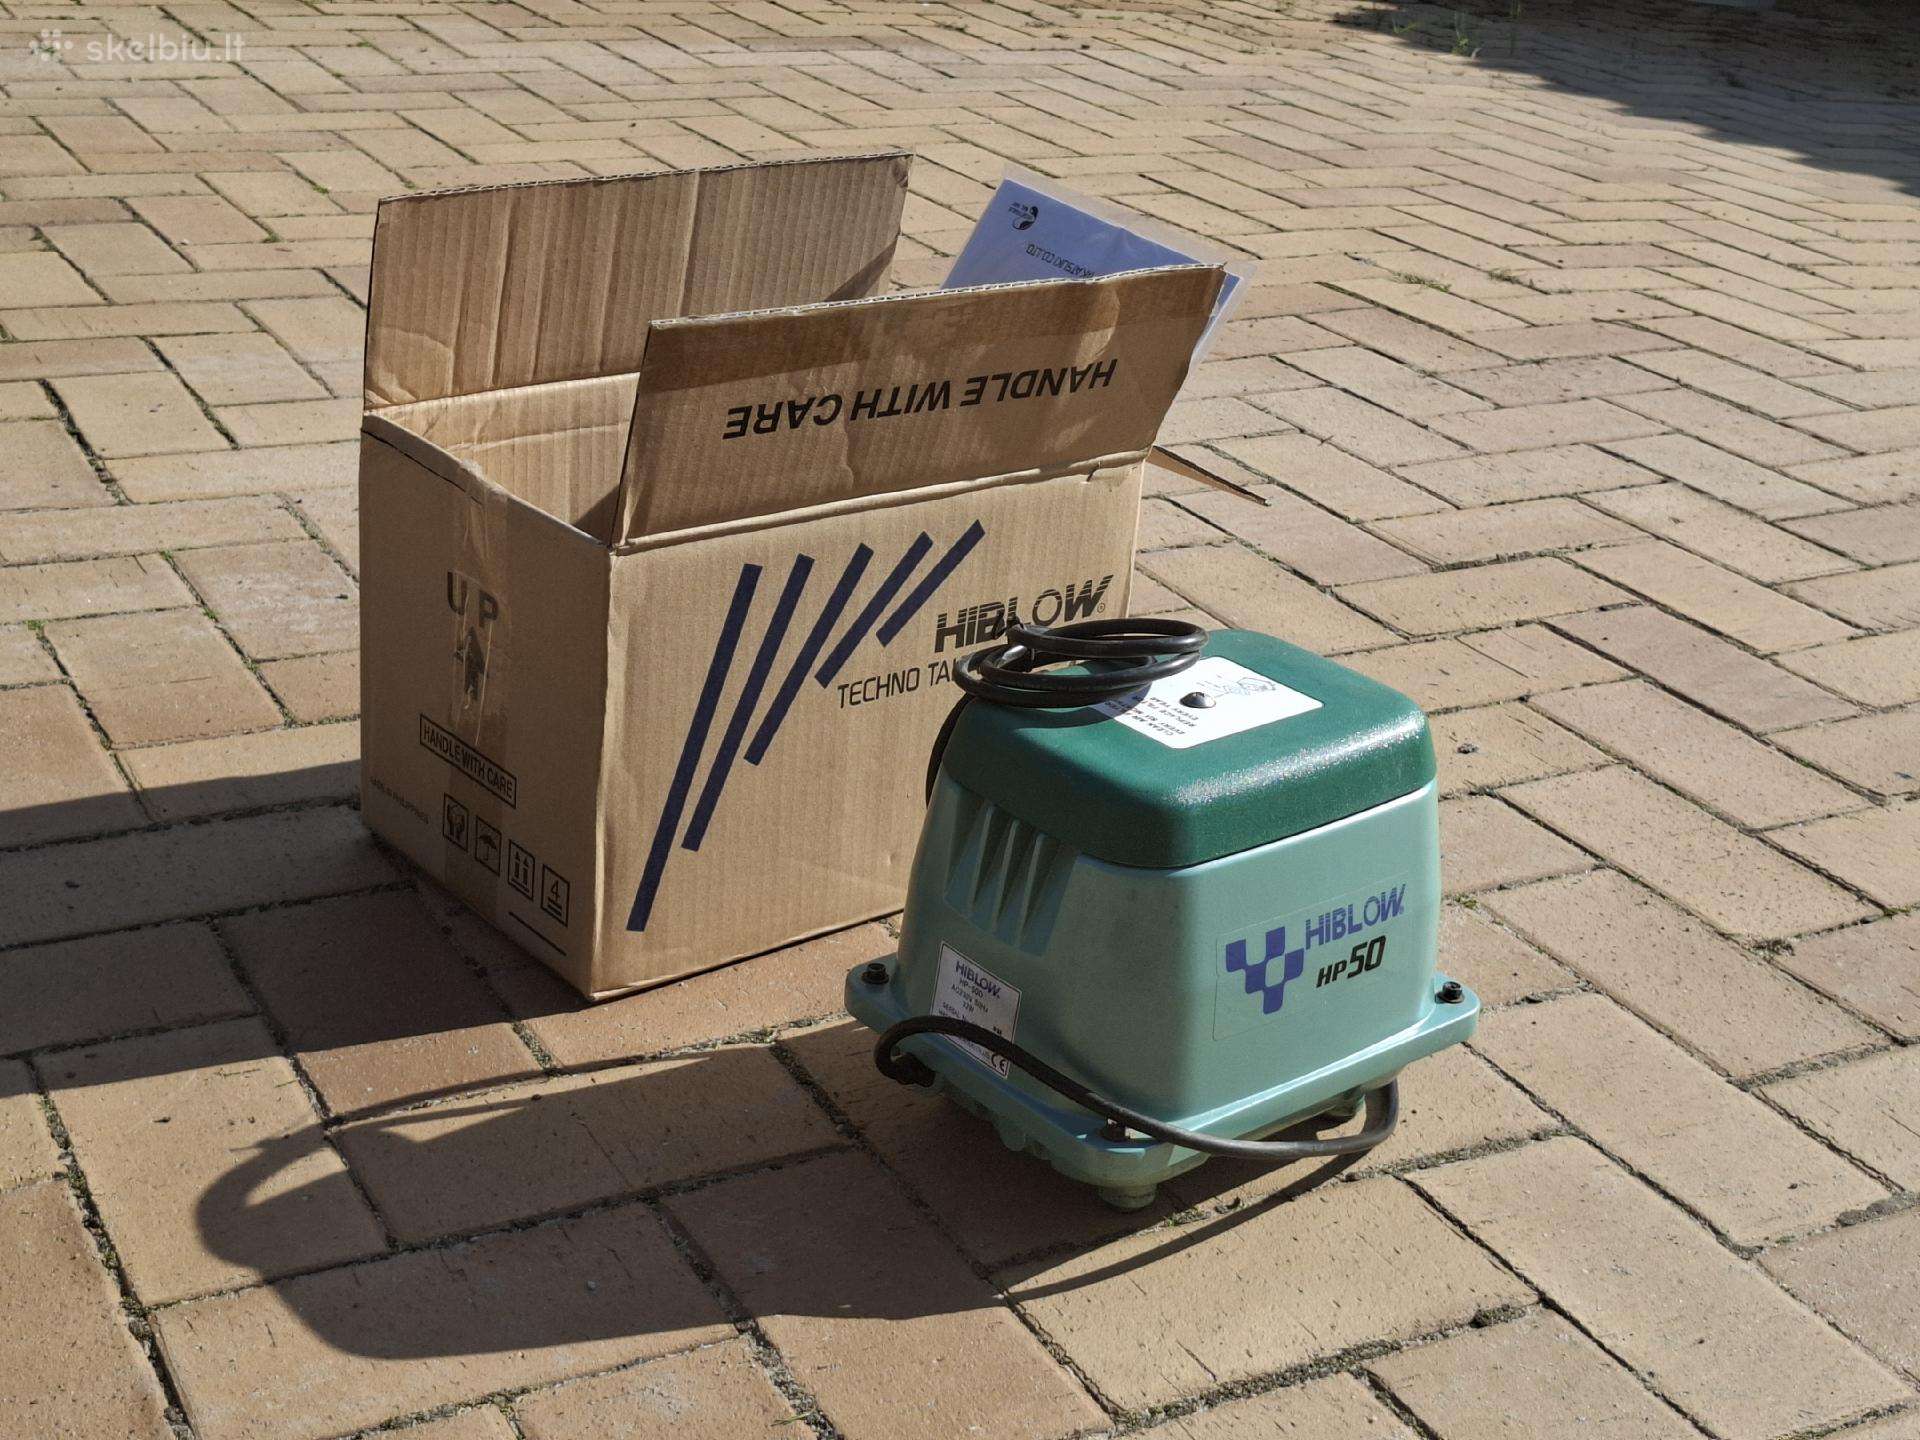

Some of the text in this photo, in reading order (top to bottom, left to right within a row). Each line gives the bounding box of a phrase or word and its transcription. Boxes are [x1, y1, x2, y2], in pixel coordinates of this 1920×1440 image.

[722, 358, 1118, 440] HANDLE WITH CARE
[446, 570, 500, 628] UP
[837, 667, 921, 709] TECHNO
[423, 722, 513, 800] HANDLE WITH CARE
[1305, 884, 1406, 950] HIBLOW
[955, 961, 1001, 996] HIBLOW
[1316, 935, 1386, 988] HP50
